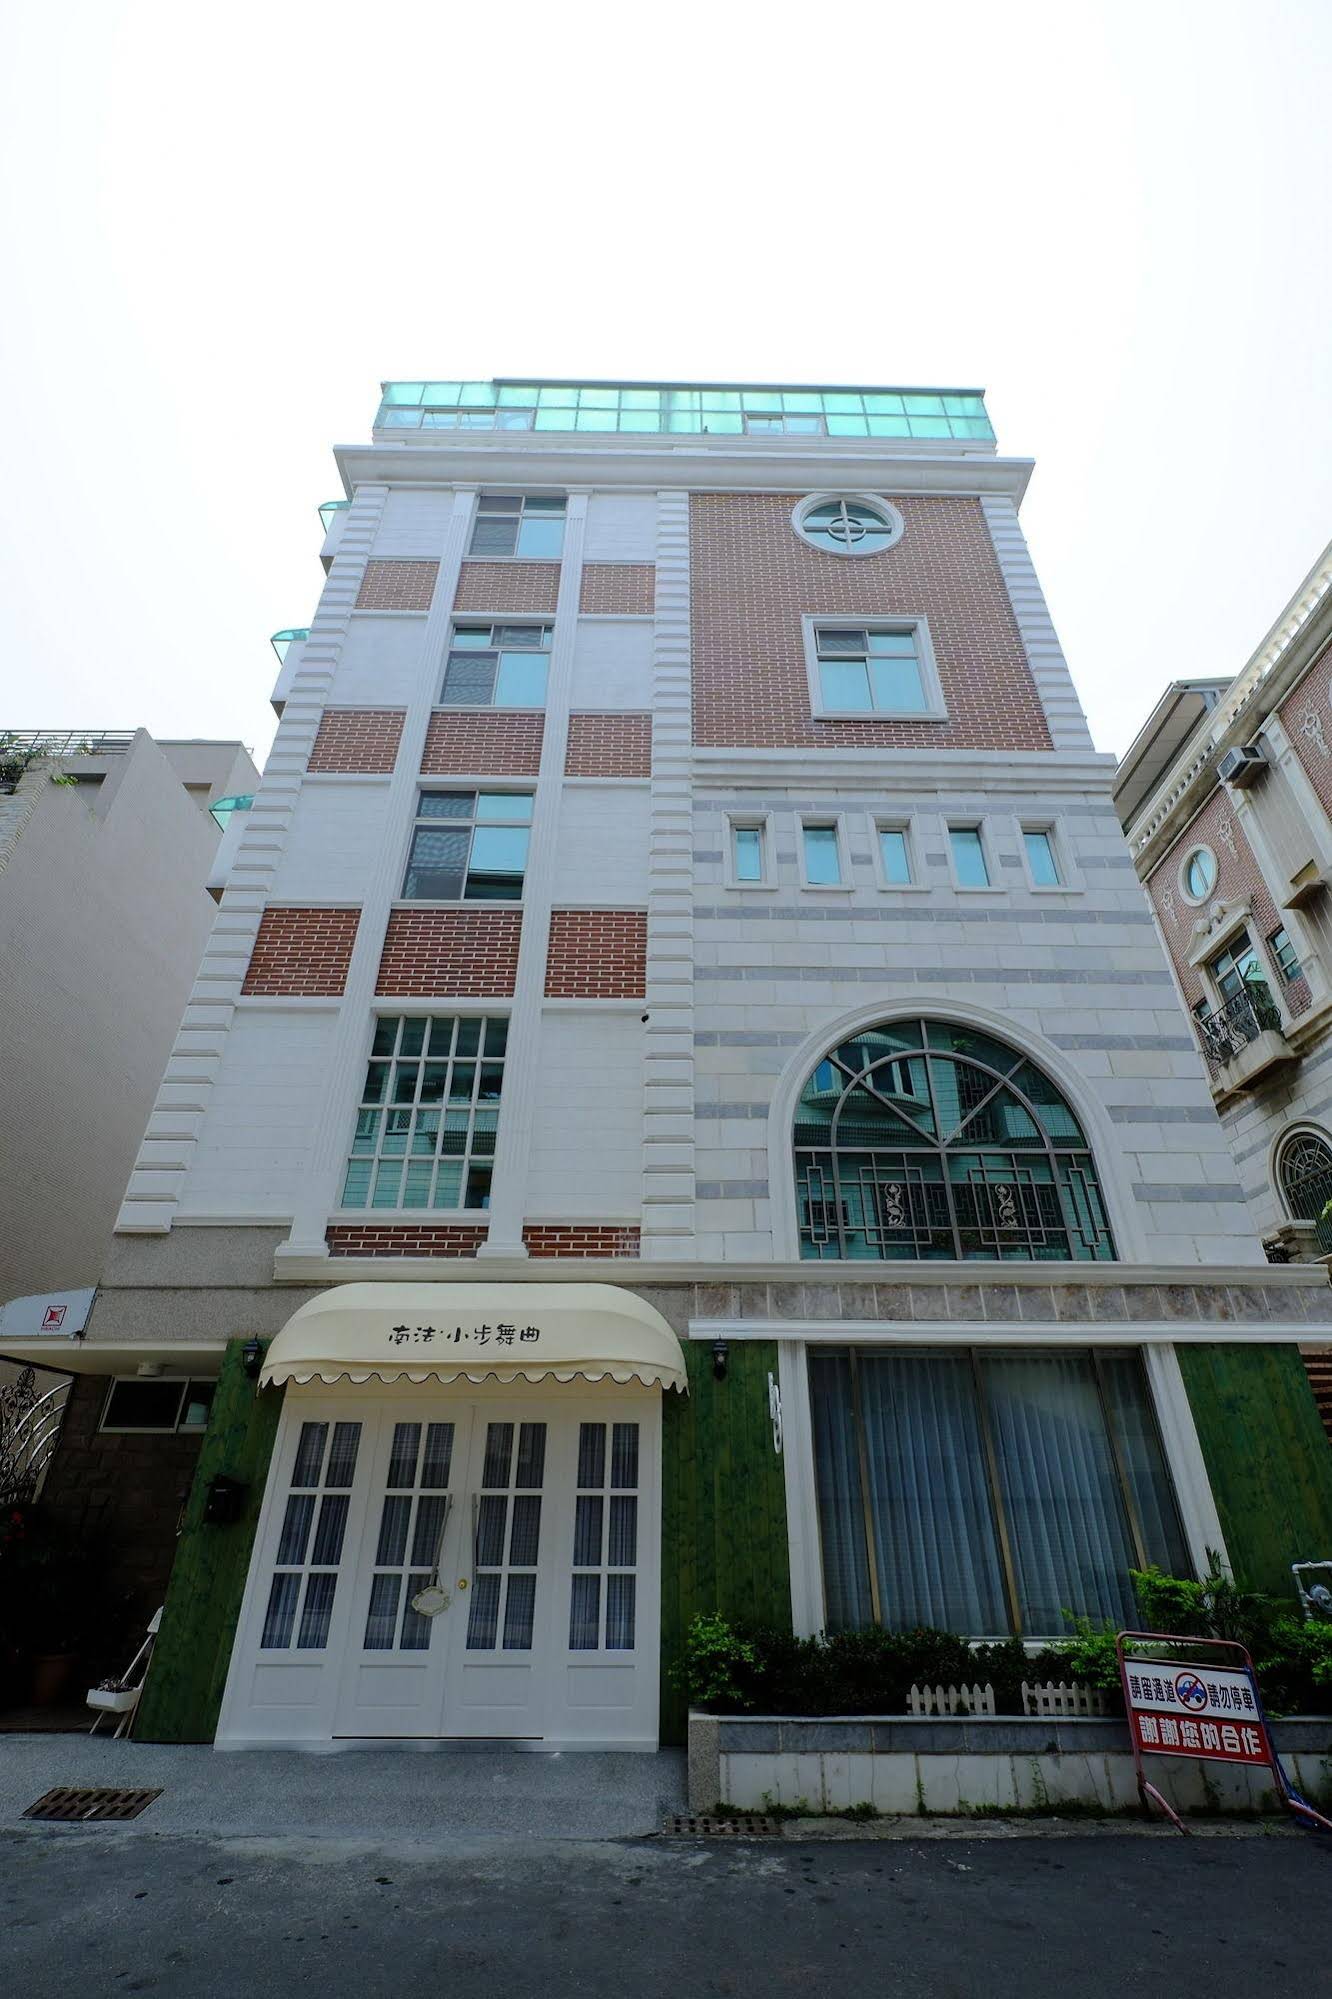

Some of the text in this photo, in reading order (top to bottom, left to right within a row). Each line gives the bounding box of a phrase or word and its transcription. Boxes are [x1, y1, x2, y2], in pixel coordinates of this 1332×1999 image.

[1207, 1683, 1254, 1711] 請勿停車
[1138, 1715, 1262, 1755] 謝謝您的合作
